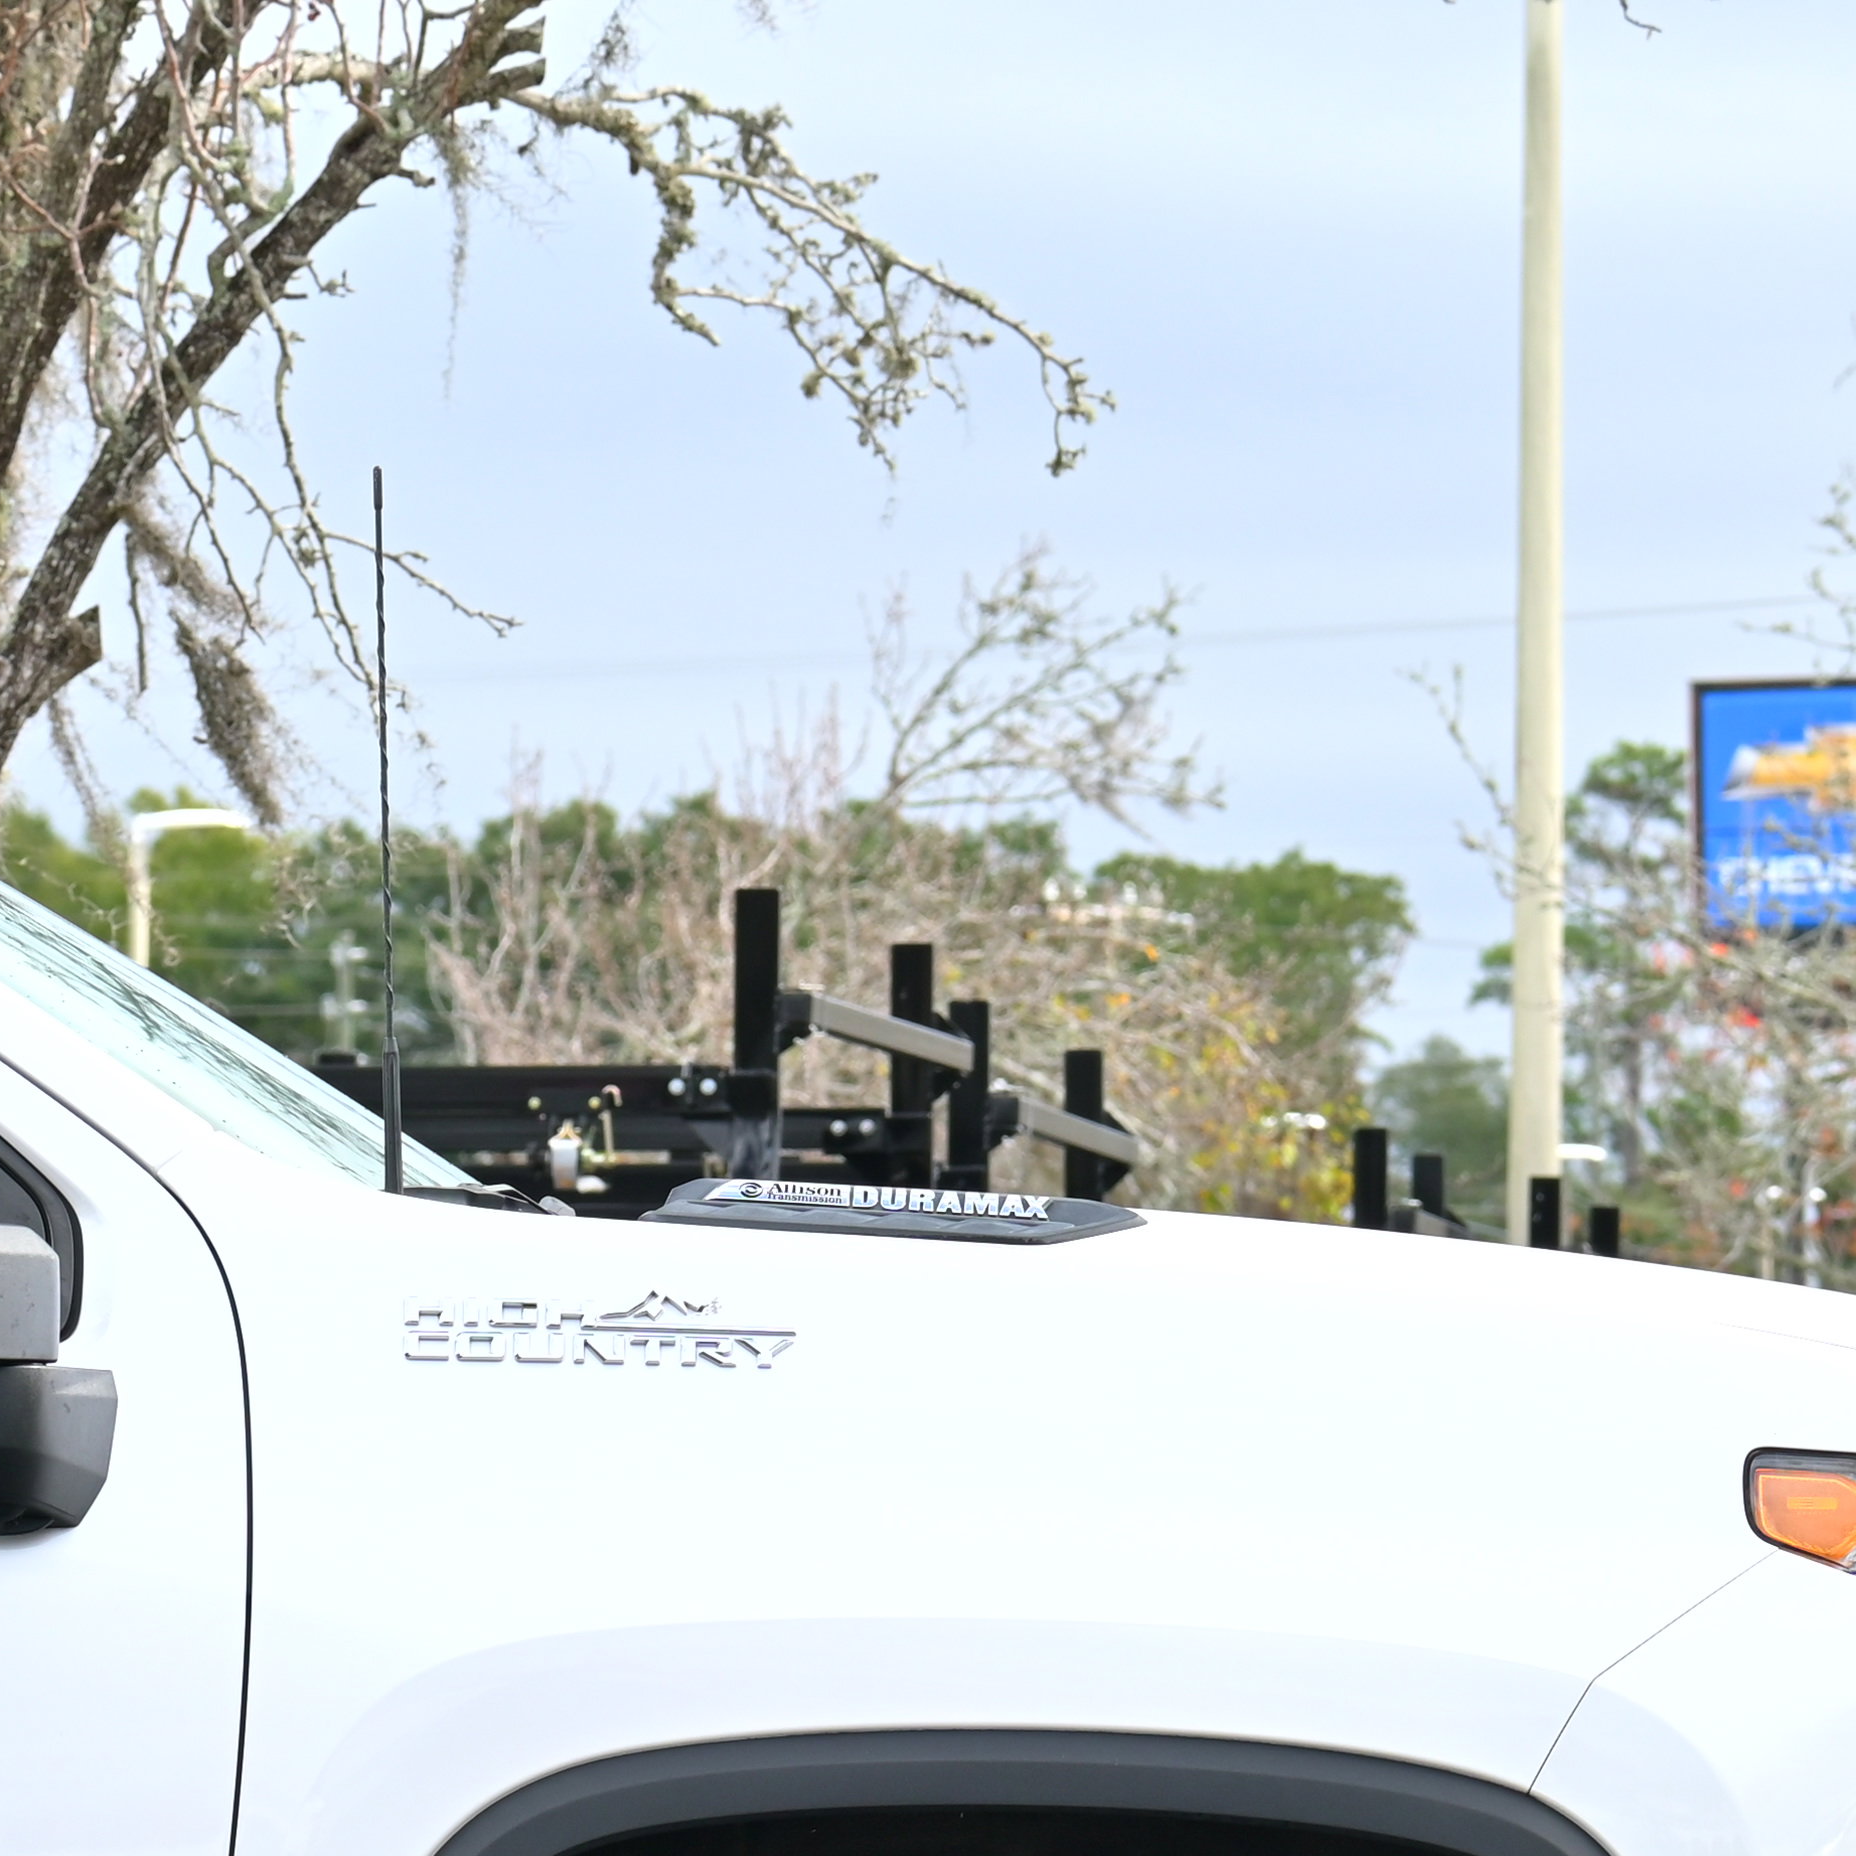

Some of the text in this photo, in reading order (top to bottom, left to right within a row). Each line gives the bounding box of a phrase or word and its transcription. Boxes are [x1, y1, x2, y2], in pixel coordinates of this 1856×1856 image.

[766, 1192, 843, 1204] Transmission
[769, 1183, 841, 1196] Allison
[852, 1186, 1050, 1219] DURAMAX
[404, 1296, 599, 1330] HIGH
[403, 1330, 796, 1370] COUNTRY
